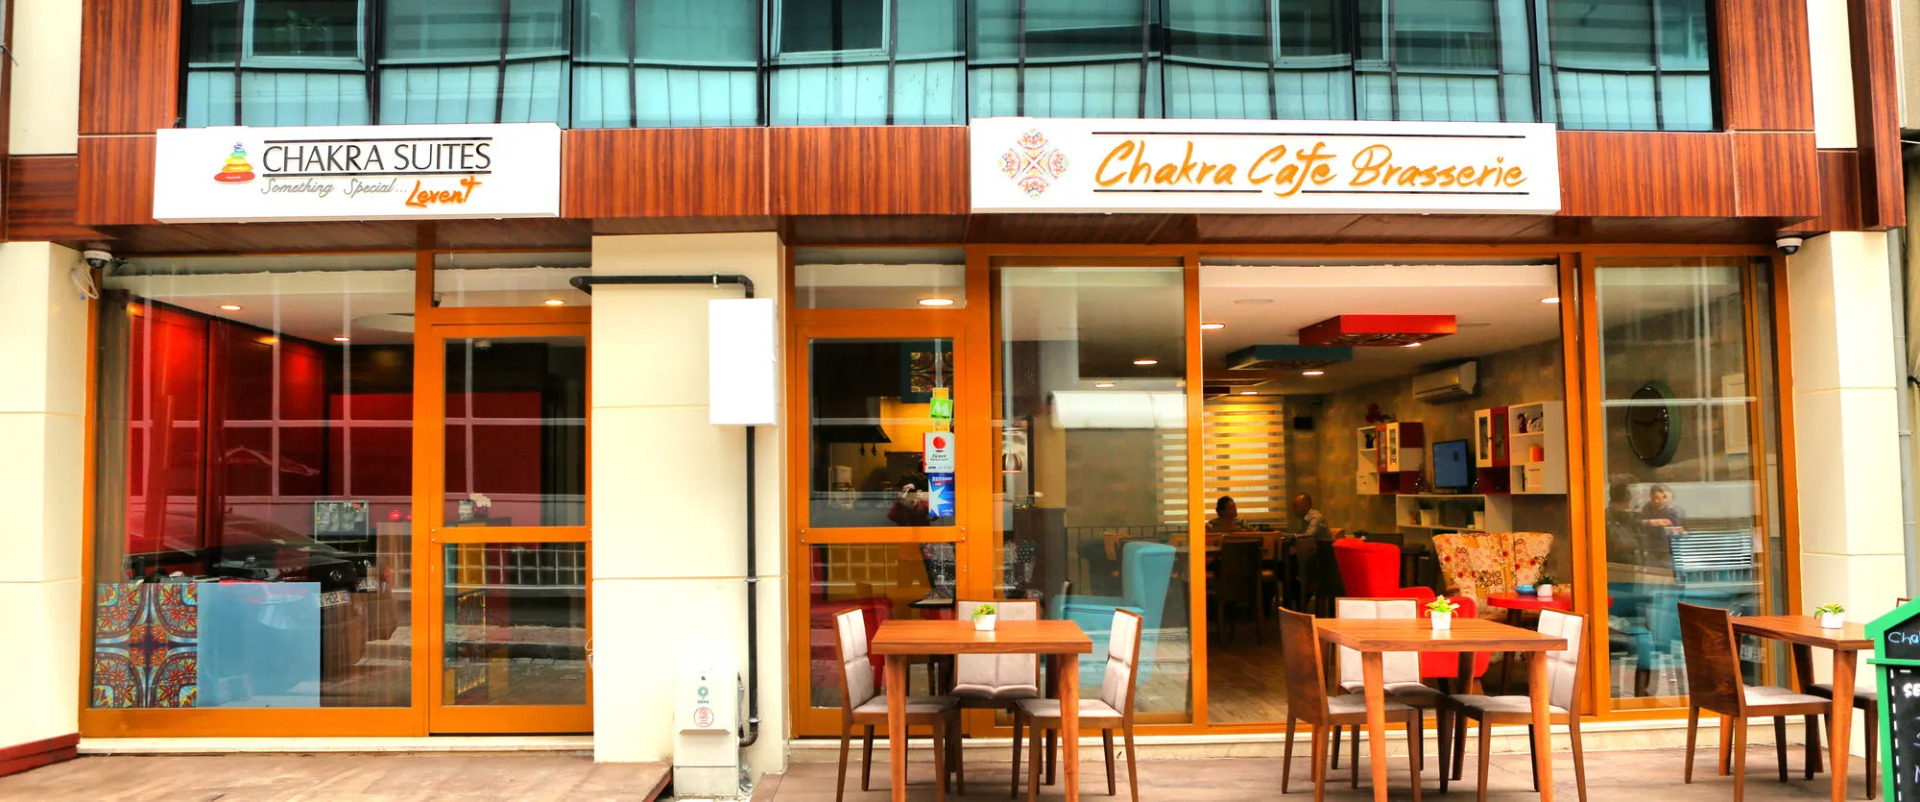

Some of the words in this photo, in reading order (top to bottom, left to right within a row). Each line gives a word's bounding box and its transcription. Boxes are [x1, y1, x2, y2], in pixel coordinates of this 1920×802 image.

[263, 145, 384, 172] CHAKRA
[394, 143, 491, 170] SUITES
[1095, 140, 1237, 186] Chakra
[1248, 141, 1337, 198] Cafe
[1348, 144, 1527, 187] Brasserie
[261, 178, 334, 198] Something
[405, 176, 482, 208] Levent
